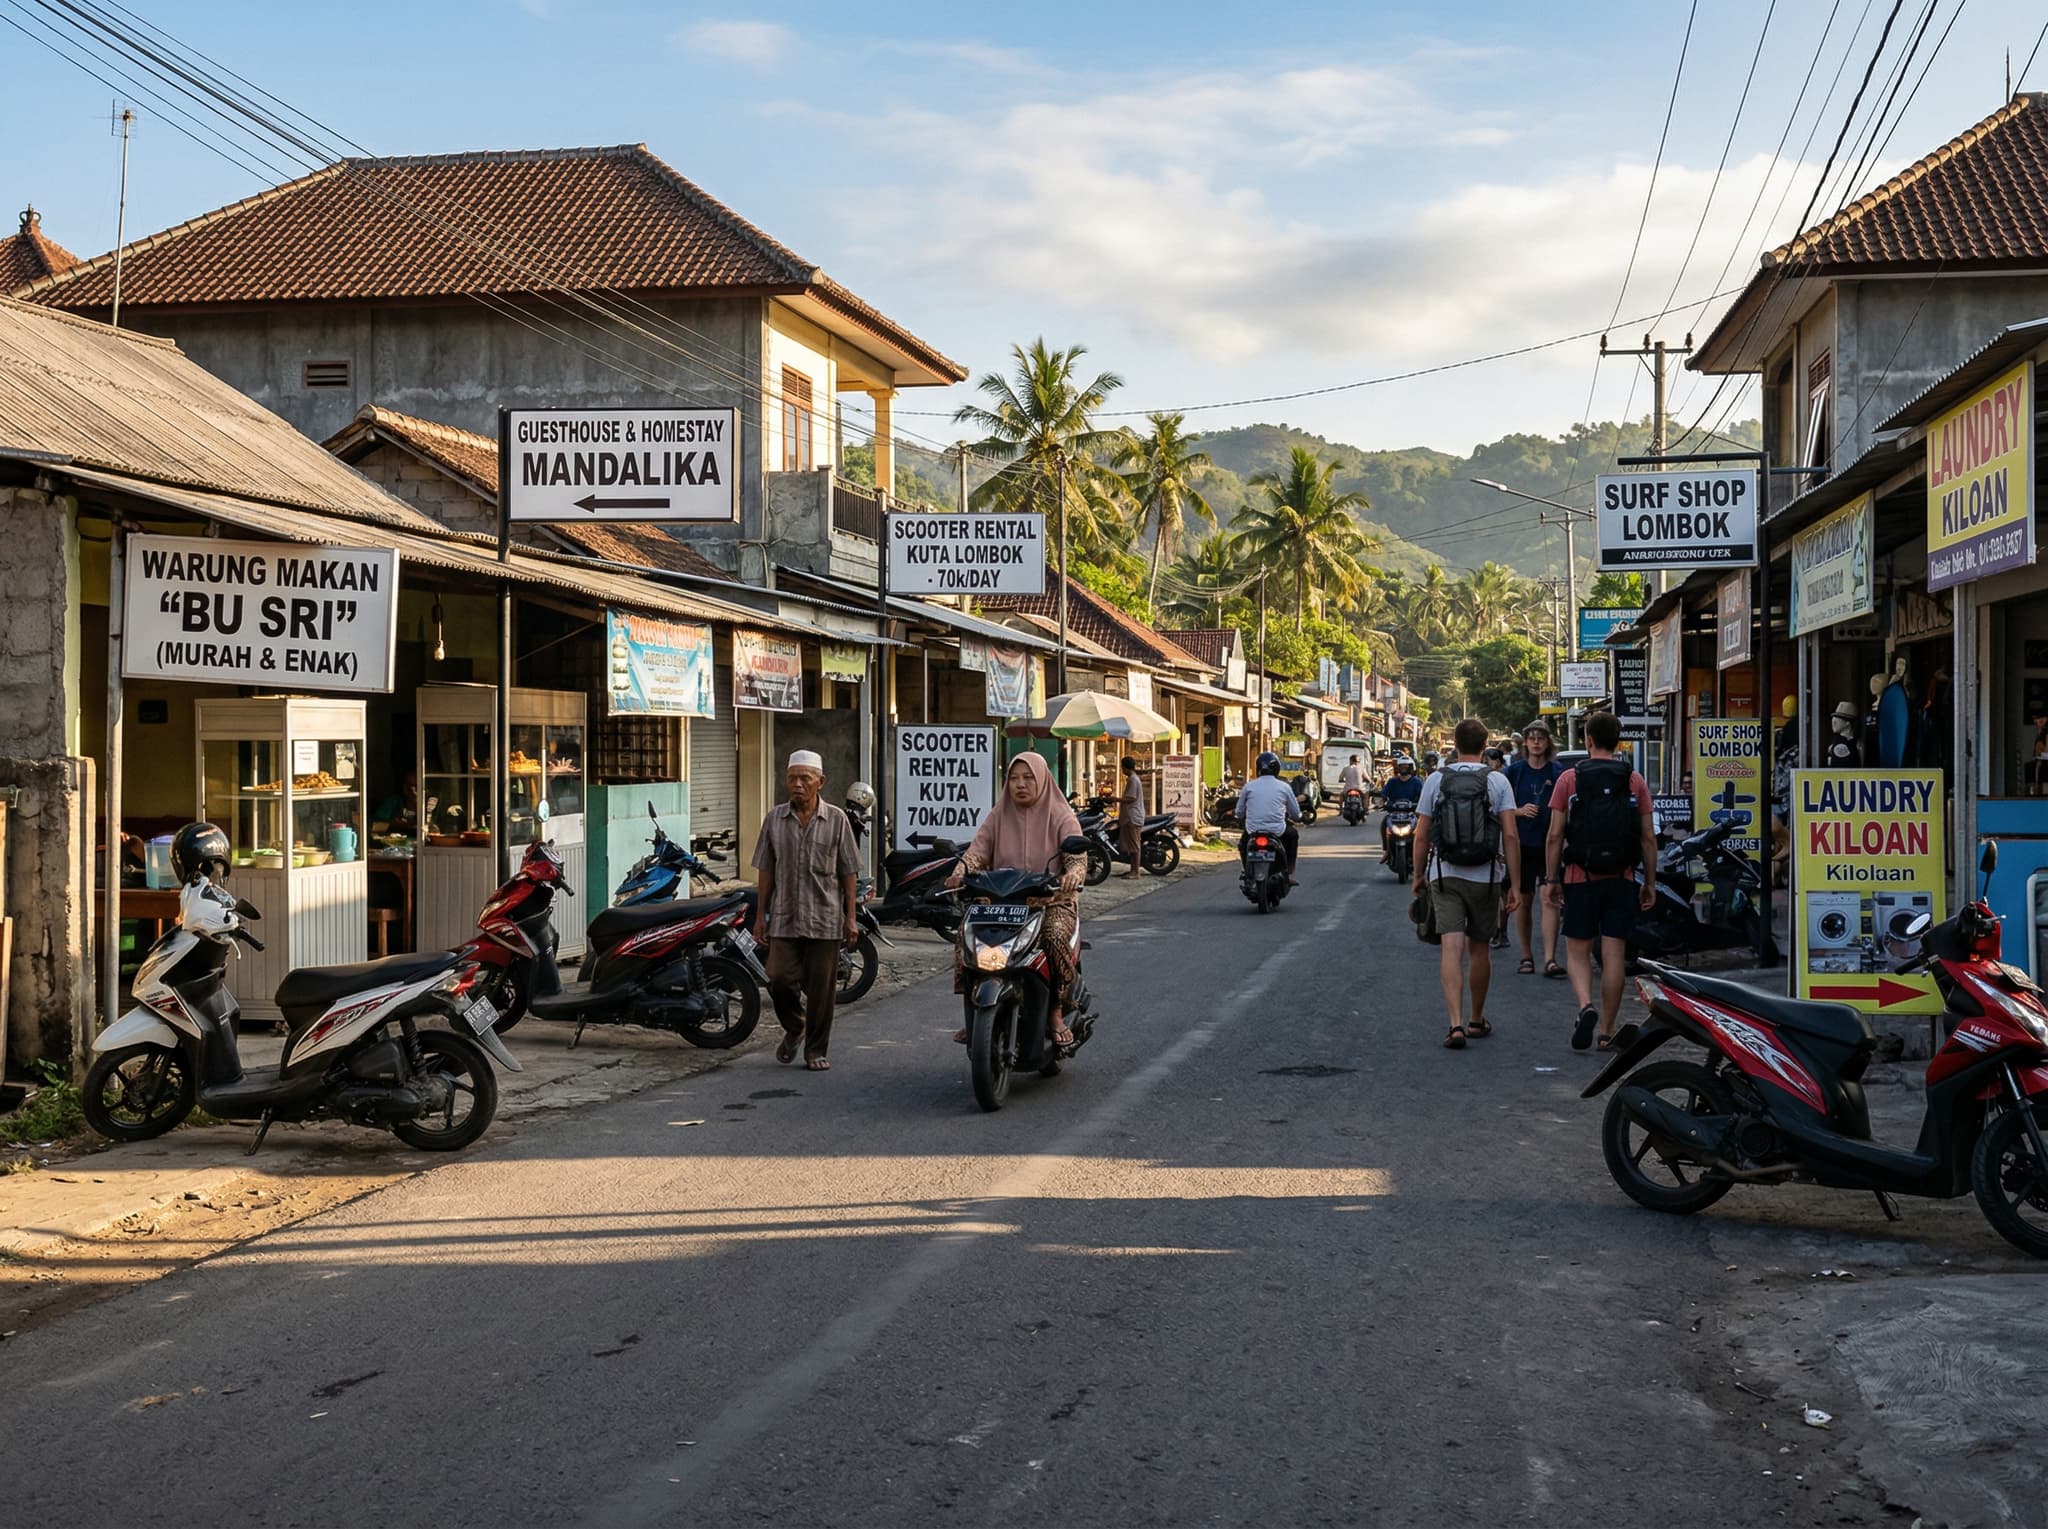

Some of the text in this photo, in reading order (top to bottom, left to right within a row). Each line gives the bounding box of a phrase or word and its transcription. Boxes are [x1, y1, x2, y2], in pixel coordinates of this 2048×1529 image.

[518, 420, 725, 443] GUESTHOUSE & HOMESTAY
[1931, 376, 2023, 489] LAUNDRY
[522, 451, 721, 486] MANDALIKA
[1604, 479, 1746, 510] SURF SHOP
[1942, 467, 2008, 537] KILOAN
[895, 520, 1037, 539] SCOOTER RENTAL
[1623, 511, 1731, 541] LOMBOK
[907, 545, 1024, 564] KUTA LOMBOK
[142, 549, 379, 592] WARUNG MAKAN
[937, 568, 1001, 588] 70k/DAY
[160, 589, 357, 640] “BU SRI”
[156, 641, 358, 681] (MURAH & ENAK)
[902, 732, 988, 752] SCOOTER
[1698, 725, 1729, 740] SURF
[909, 757, 980, 777] RENTAL
[919, 782, 969, 802] KUTA
[1803, 780, 1934, 813] LAUNDRY
[907, 806, 981, 827] 70k/DAY
[1810, 821, 1928, 855] KILOAN
